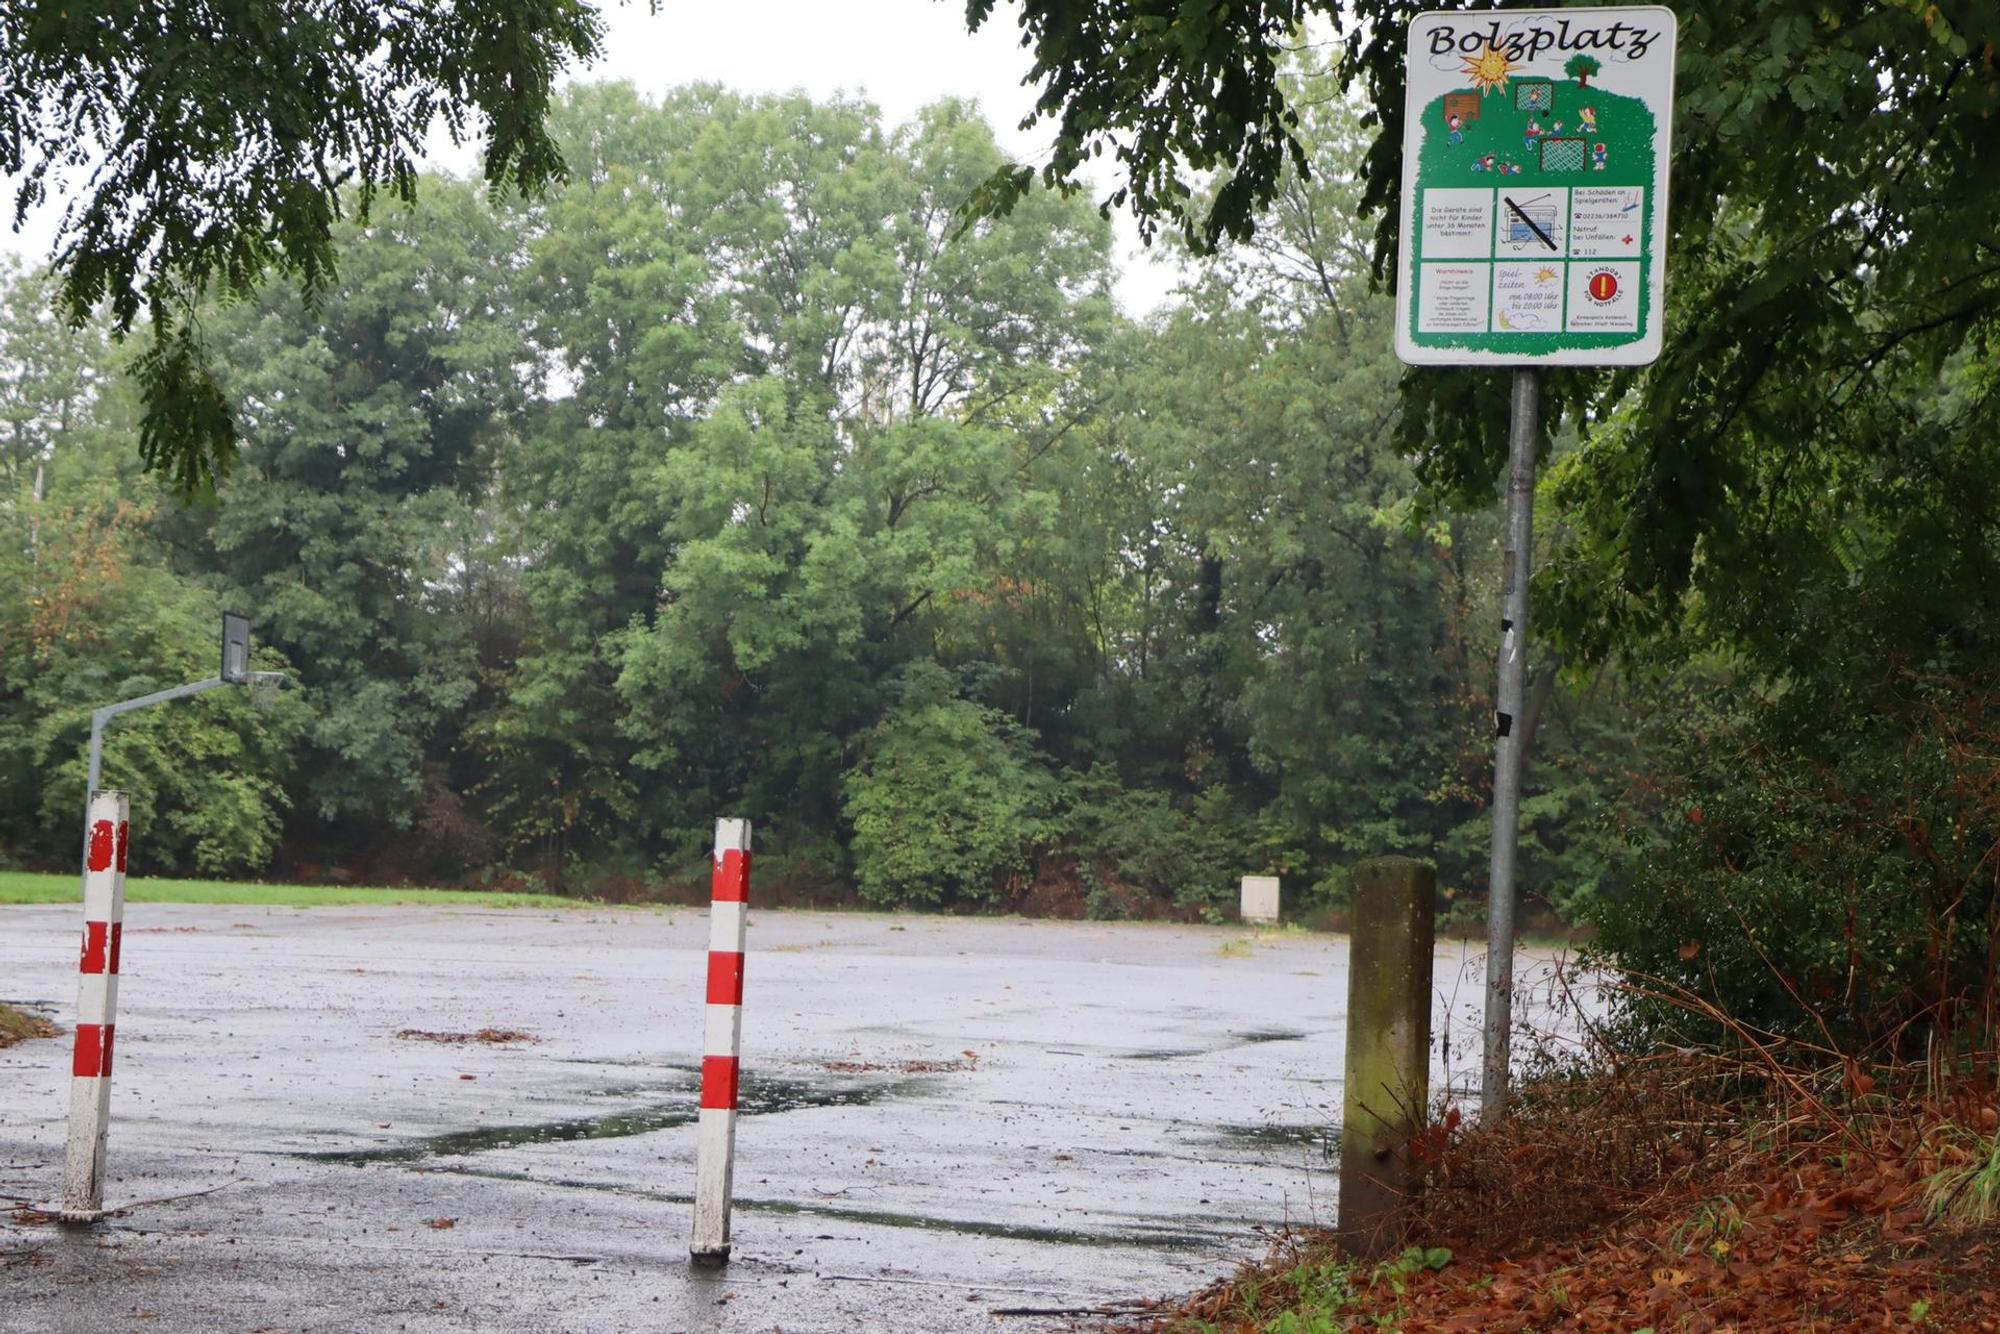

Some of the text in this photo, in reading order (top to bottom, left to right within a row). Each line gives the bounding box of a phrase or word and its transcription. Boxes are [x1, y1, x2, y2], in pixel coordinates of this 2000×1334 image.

[1427, 20, 1661, 62] Bolzplatz
[1585, 266, 1622, 280] STANDORT
[1544, 292, 1559, 300] Uhr
[1584, 290, 1624, 307] FÜR NOTFÄLLE
[1511, 302, 1521, 310] bis
[1544, 302, 1559, 310] Uhr
